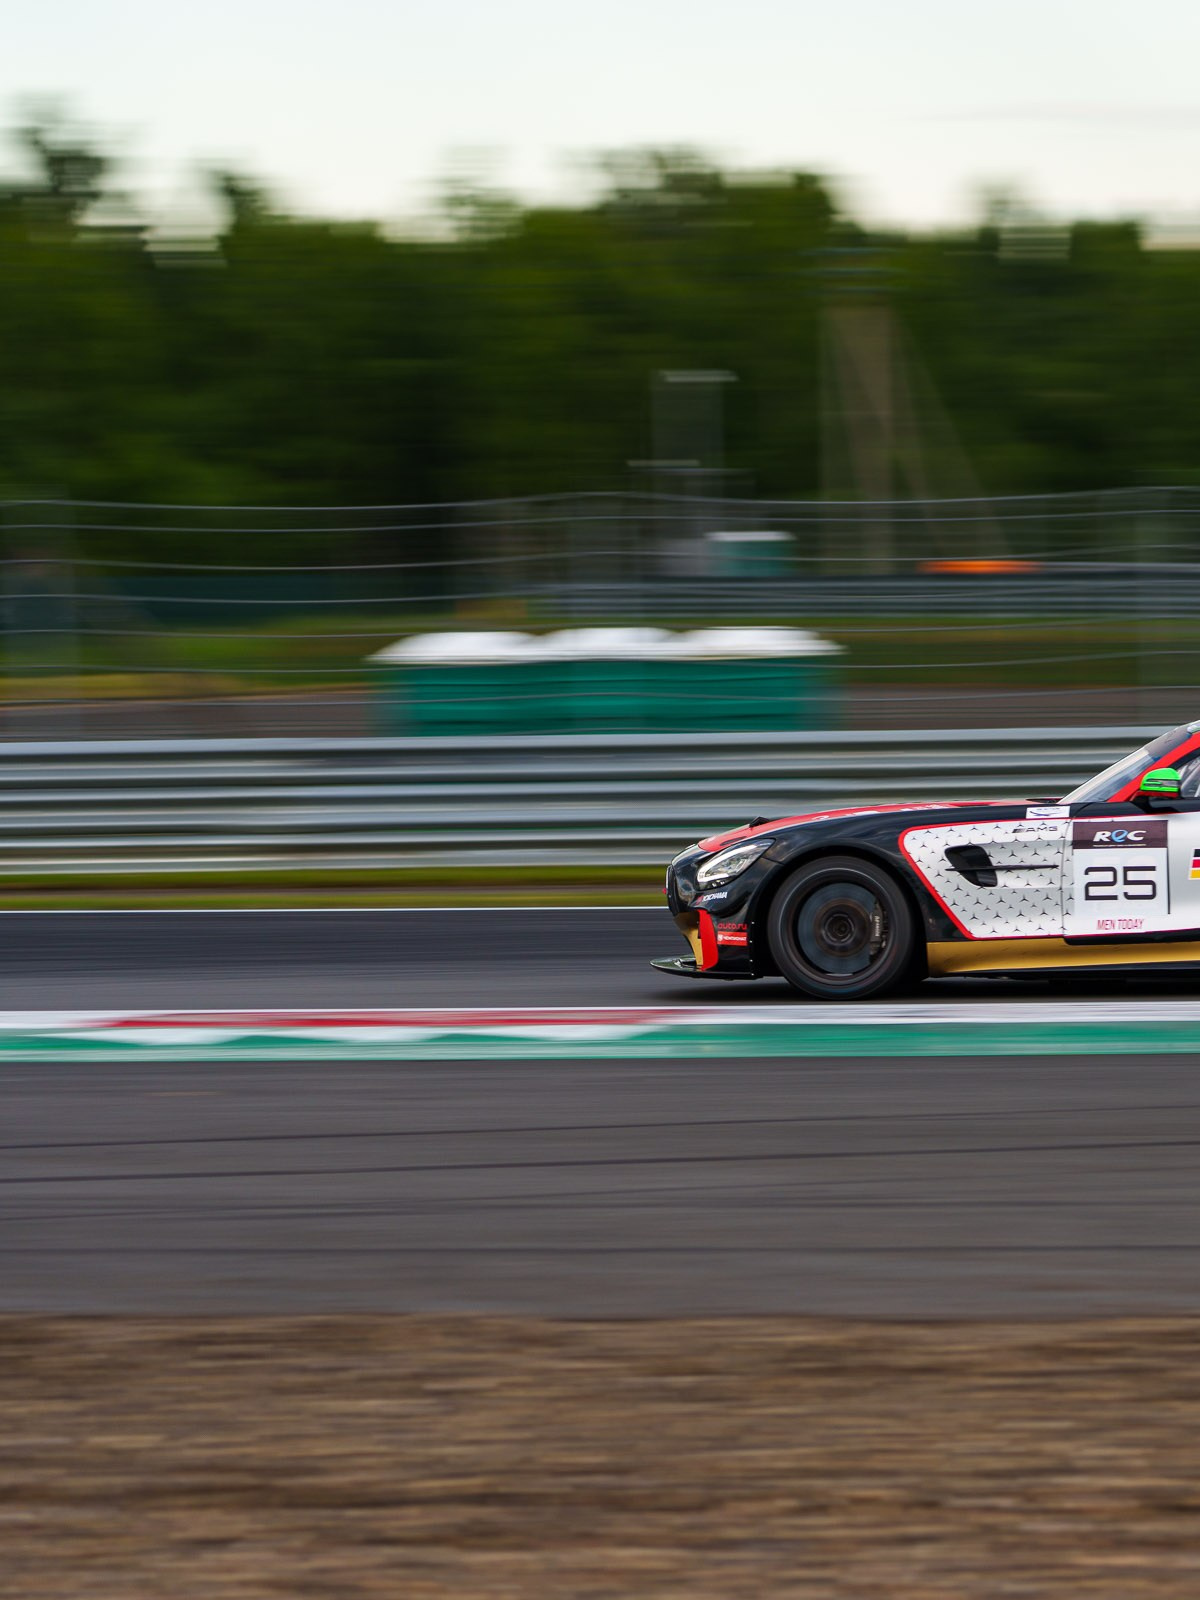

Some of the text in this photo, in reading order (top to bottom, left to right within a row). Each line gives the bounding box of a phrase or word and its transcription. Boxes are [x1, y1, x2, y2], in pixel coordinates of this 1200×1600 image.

[1084, 866, 1156, 900] 25
[1097, 918, 1144, 930] MEN TODAY
